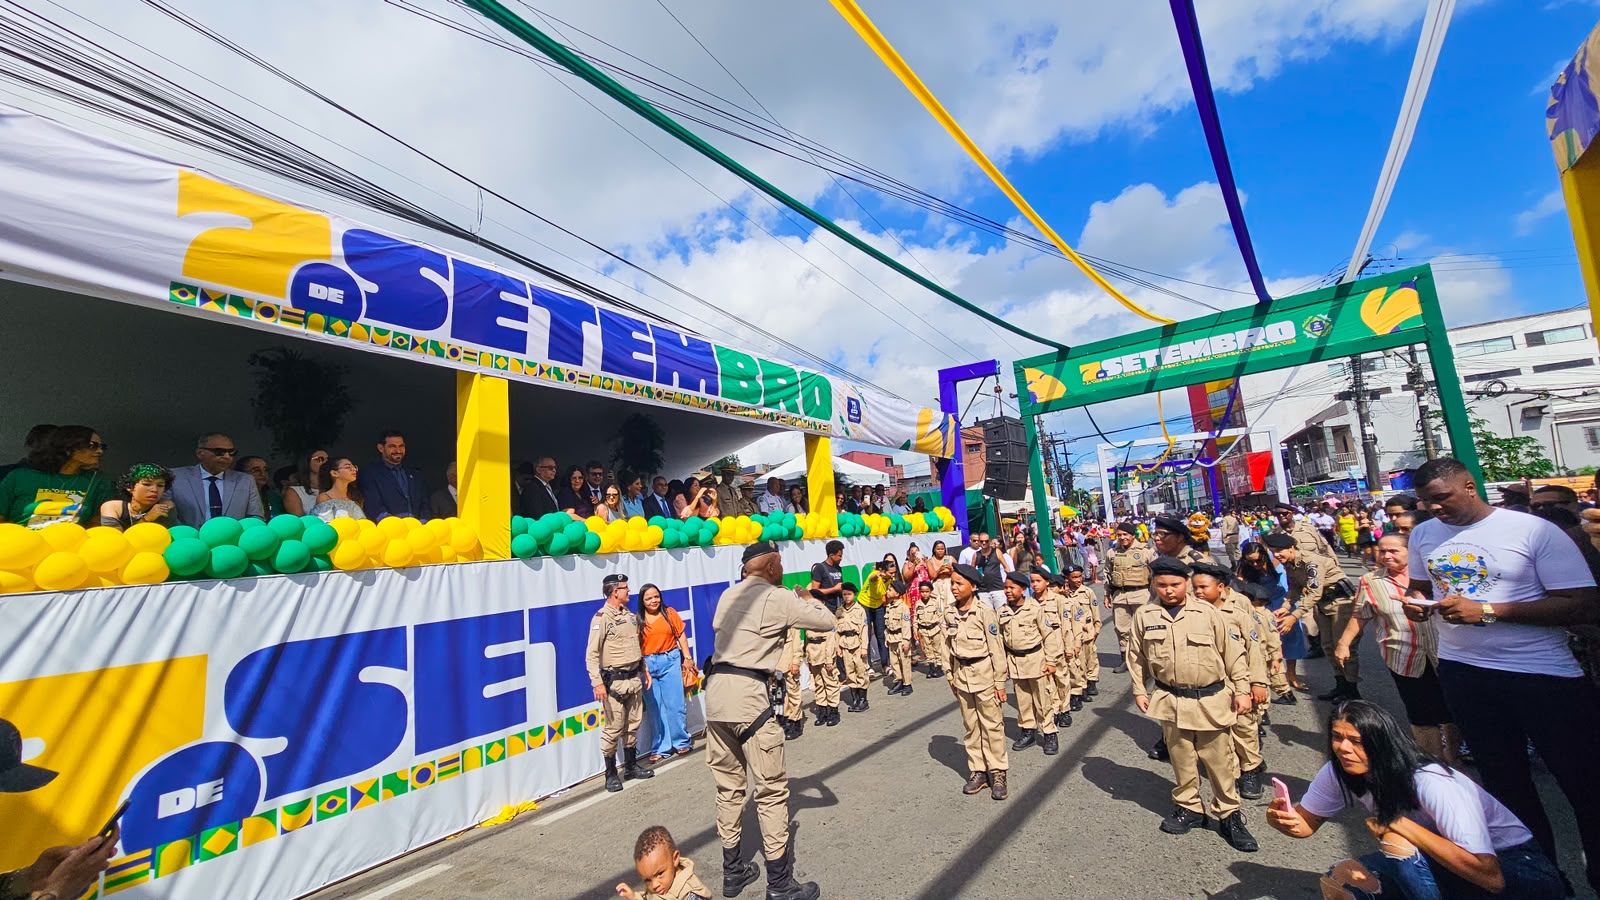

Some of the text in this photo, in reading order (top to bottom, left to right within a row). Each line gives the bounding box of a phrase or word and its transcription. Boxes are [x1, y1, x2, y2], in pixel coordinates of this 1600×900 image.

[176, 169, 833, 421] 7 DE SETEMBRO
[1079, 320, 1296, 381] 7 SETEMBRO
[157, 778, 224, 819] DE
